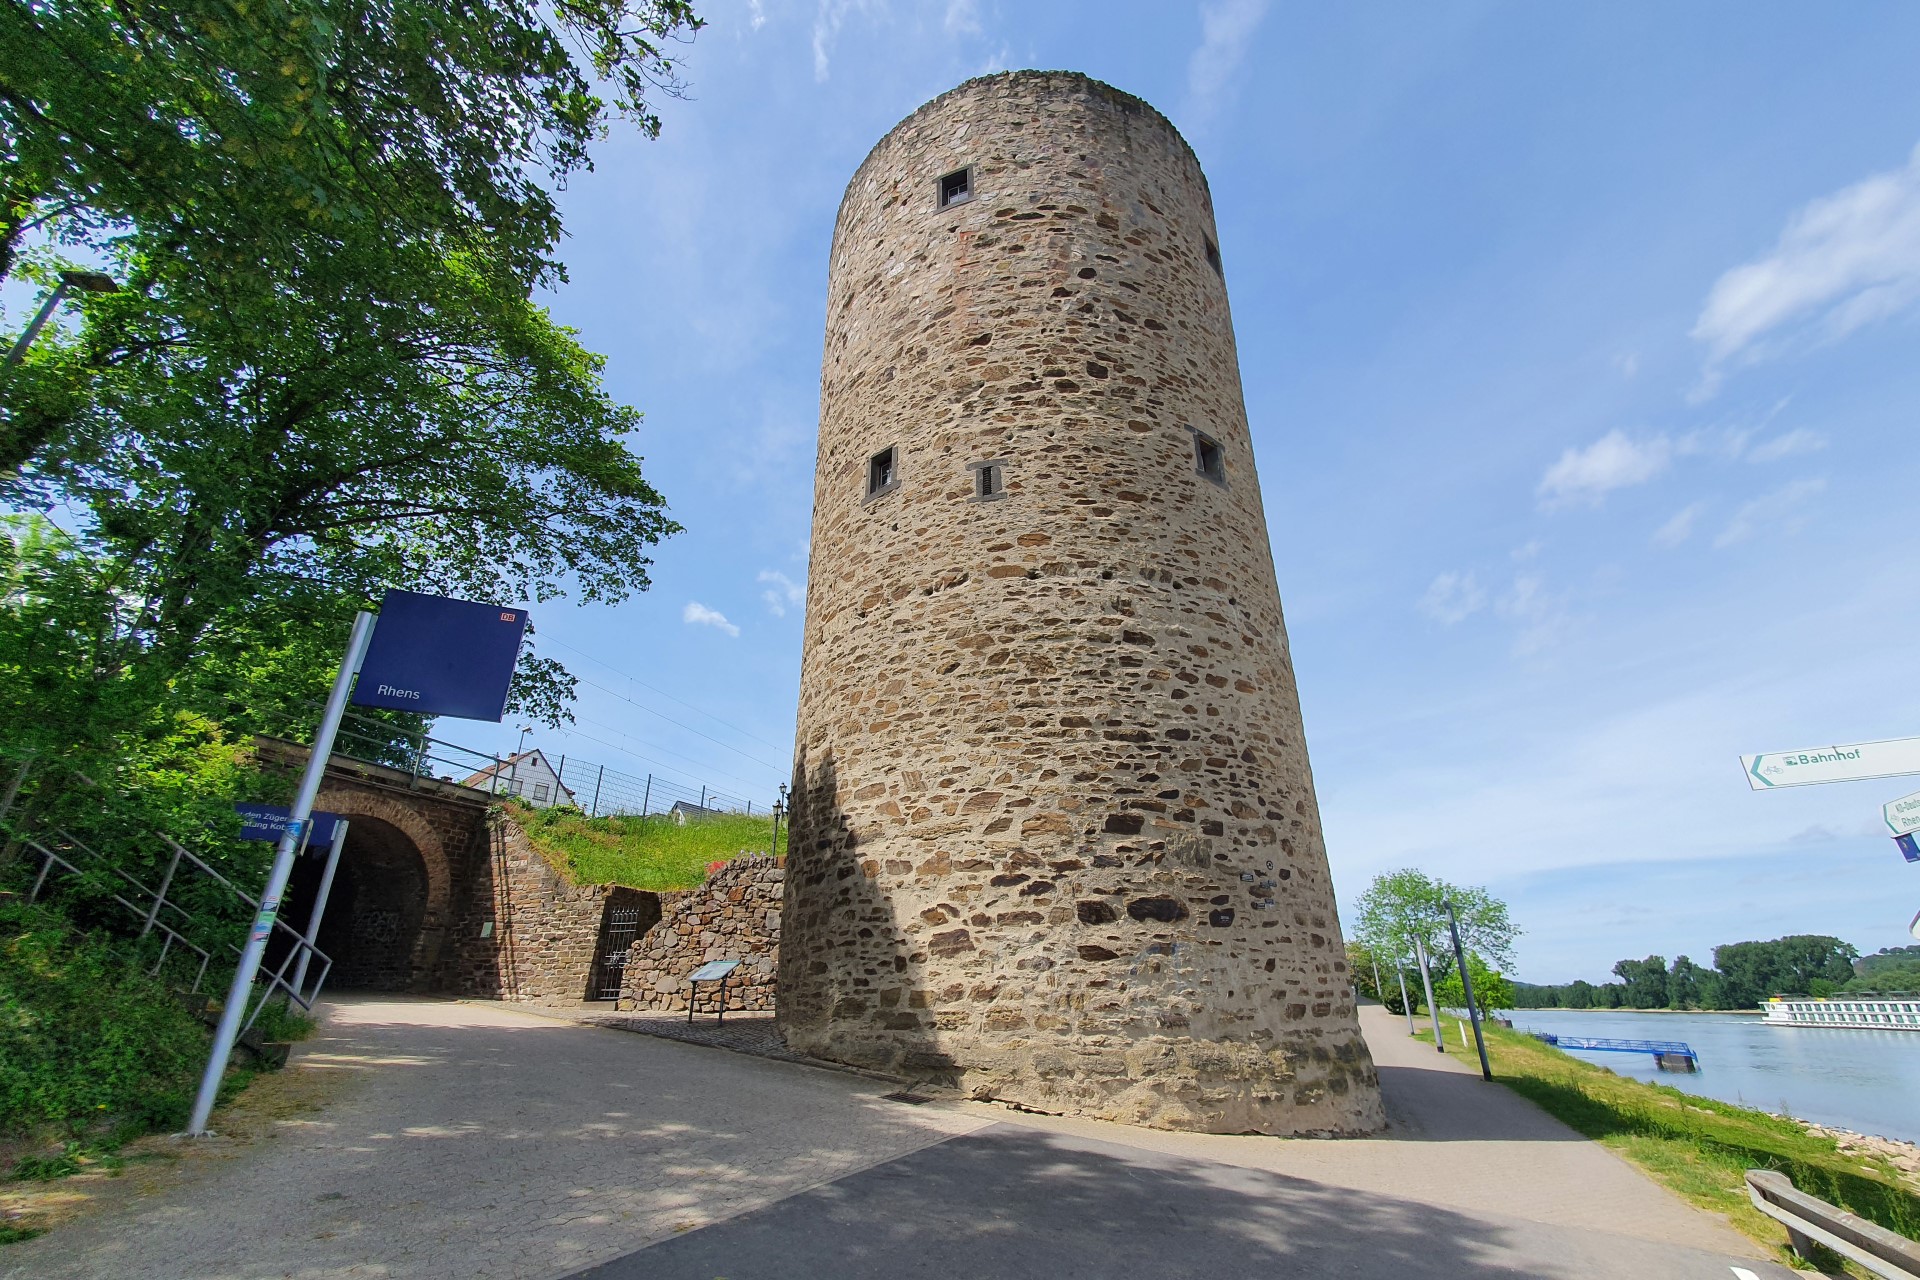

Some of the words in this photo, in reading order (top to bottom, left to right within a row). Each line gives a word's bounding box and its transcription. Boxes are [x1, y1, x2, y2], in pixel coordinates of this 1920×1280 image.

[501, 613, 515, 622] DB
[378, 684, 421, 700] Rhens
[1798, 749, 1860, 765] Bahnhof
